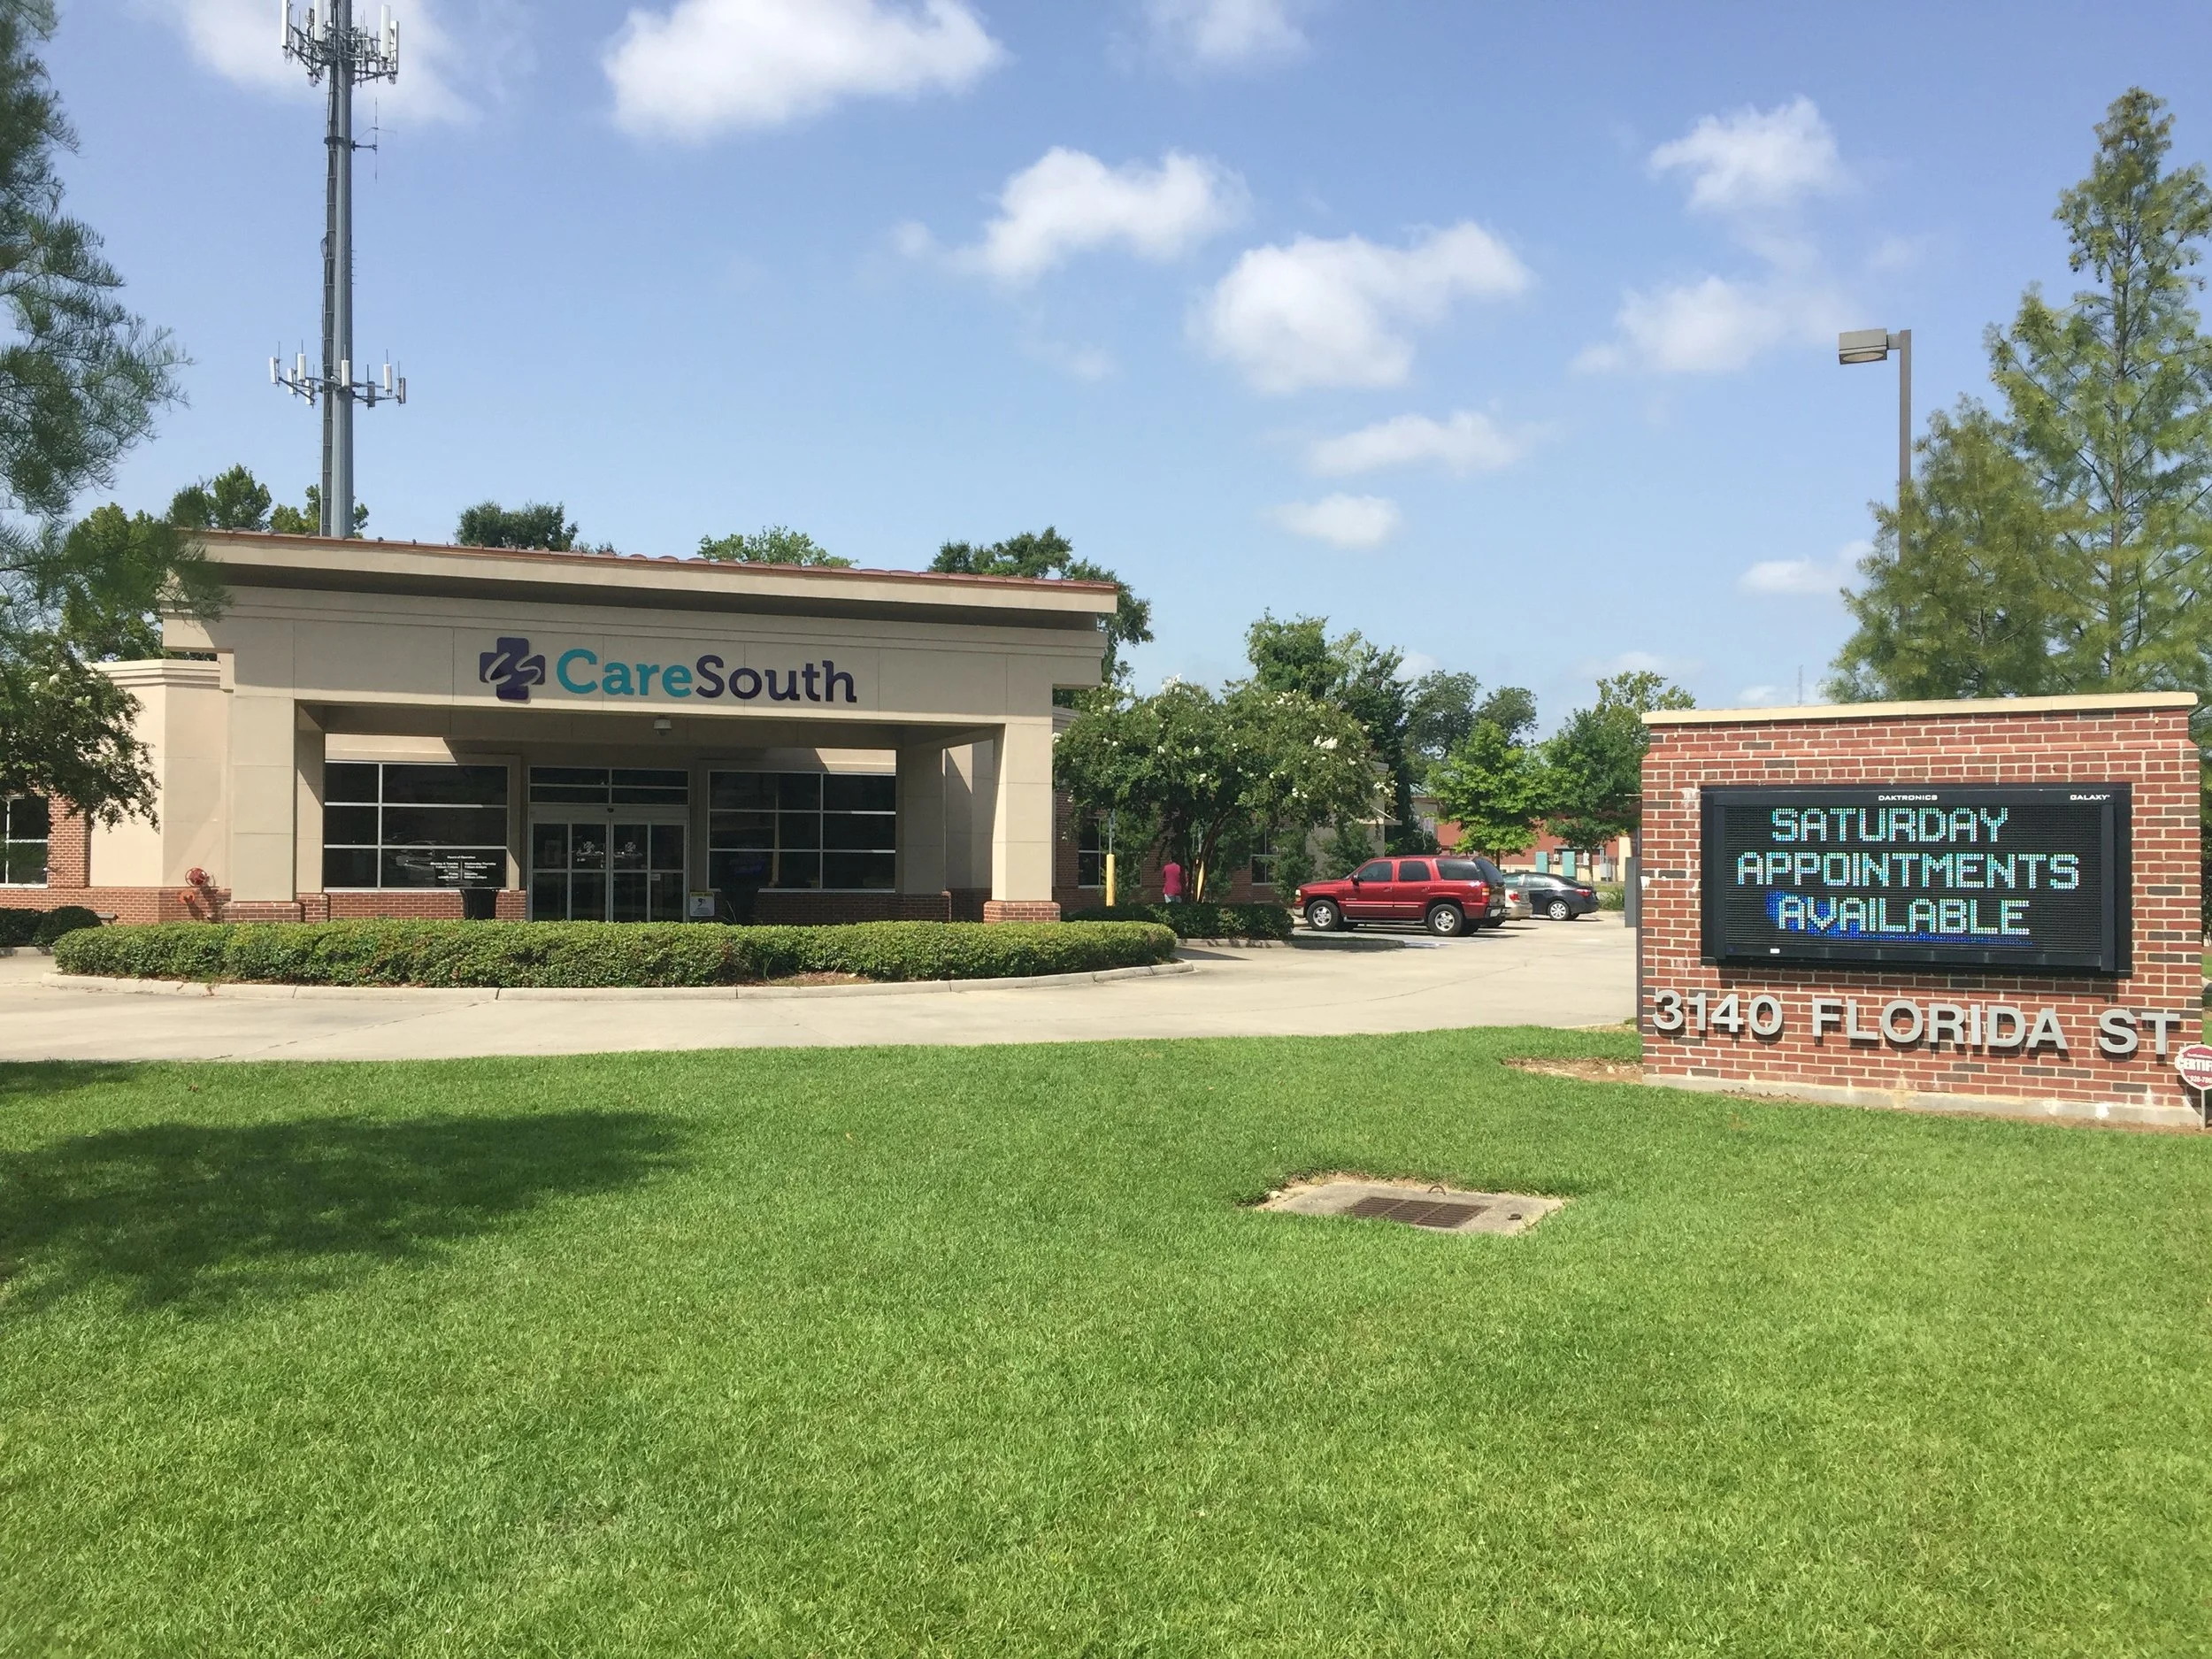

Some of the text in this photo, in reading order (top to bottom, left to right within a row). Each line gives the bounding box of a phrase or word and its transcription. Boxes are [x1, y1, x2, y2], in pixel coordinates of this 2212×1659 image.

[557, 649, 857, 703] CareSouth
[1771, 807, 2008, 842] SATURDAY
[1737, 851, 2080, 889] APPOINTMENTS
[1778, 895, 2031, 935] AVAILABLE
[1653, 989, 2181, 1056] 3140 FLORIDA ST
